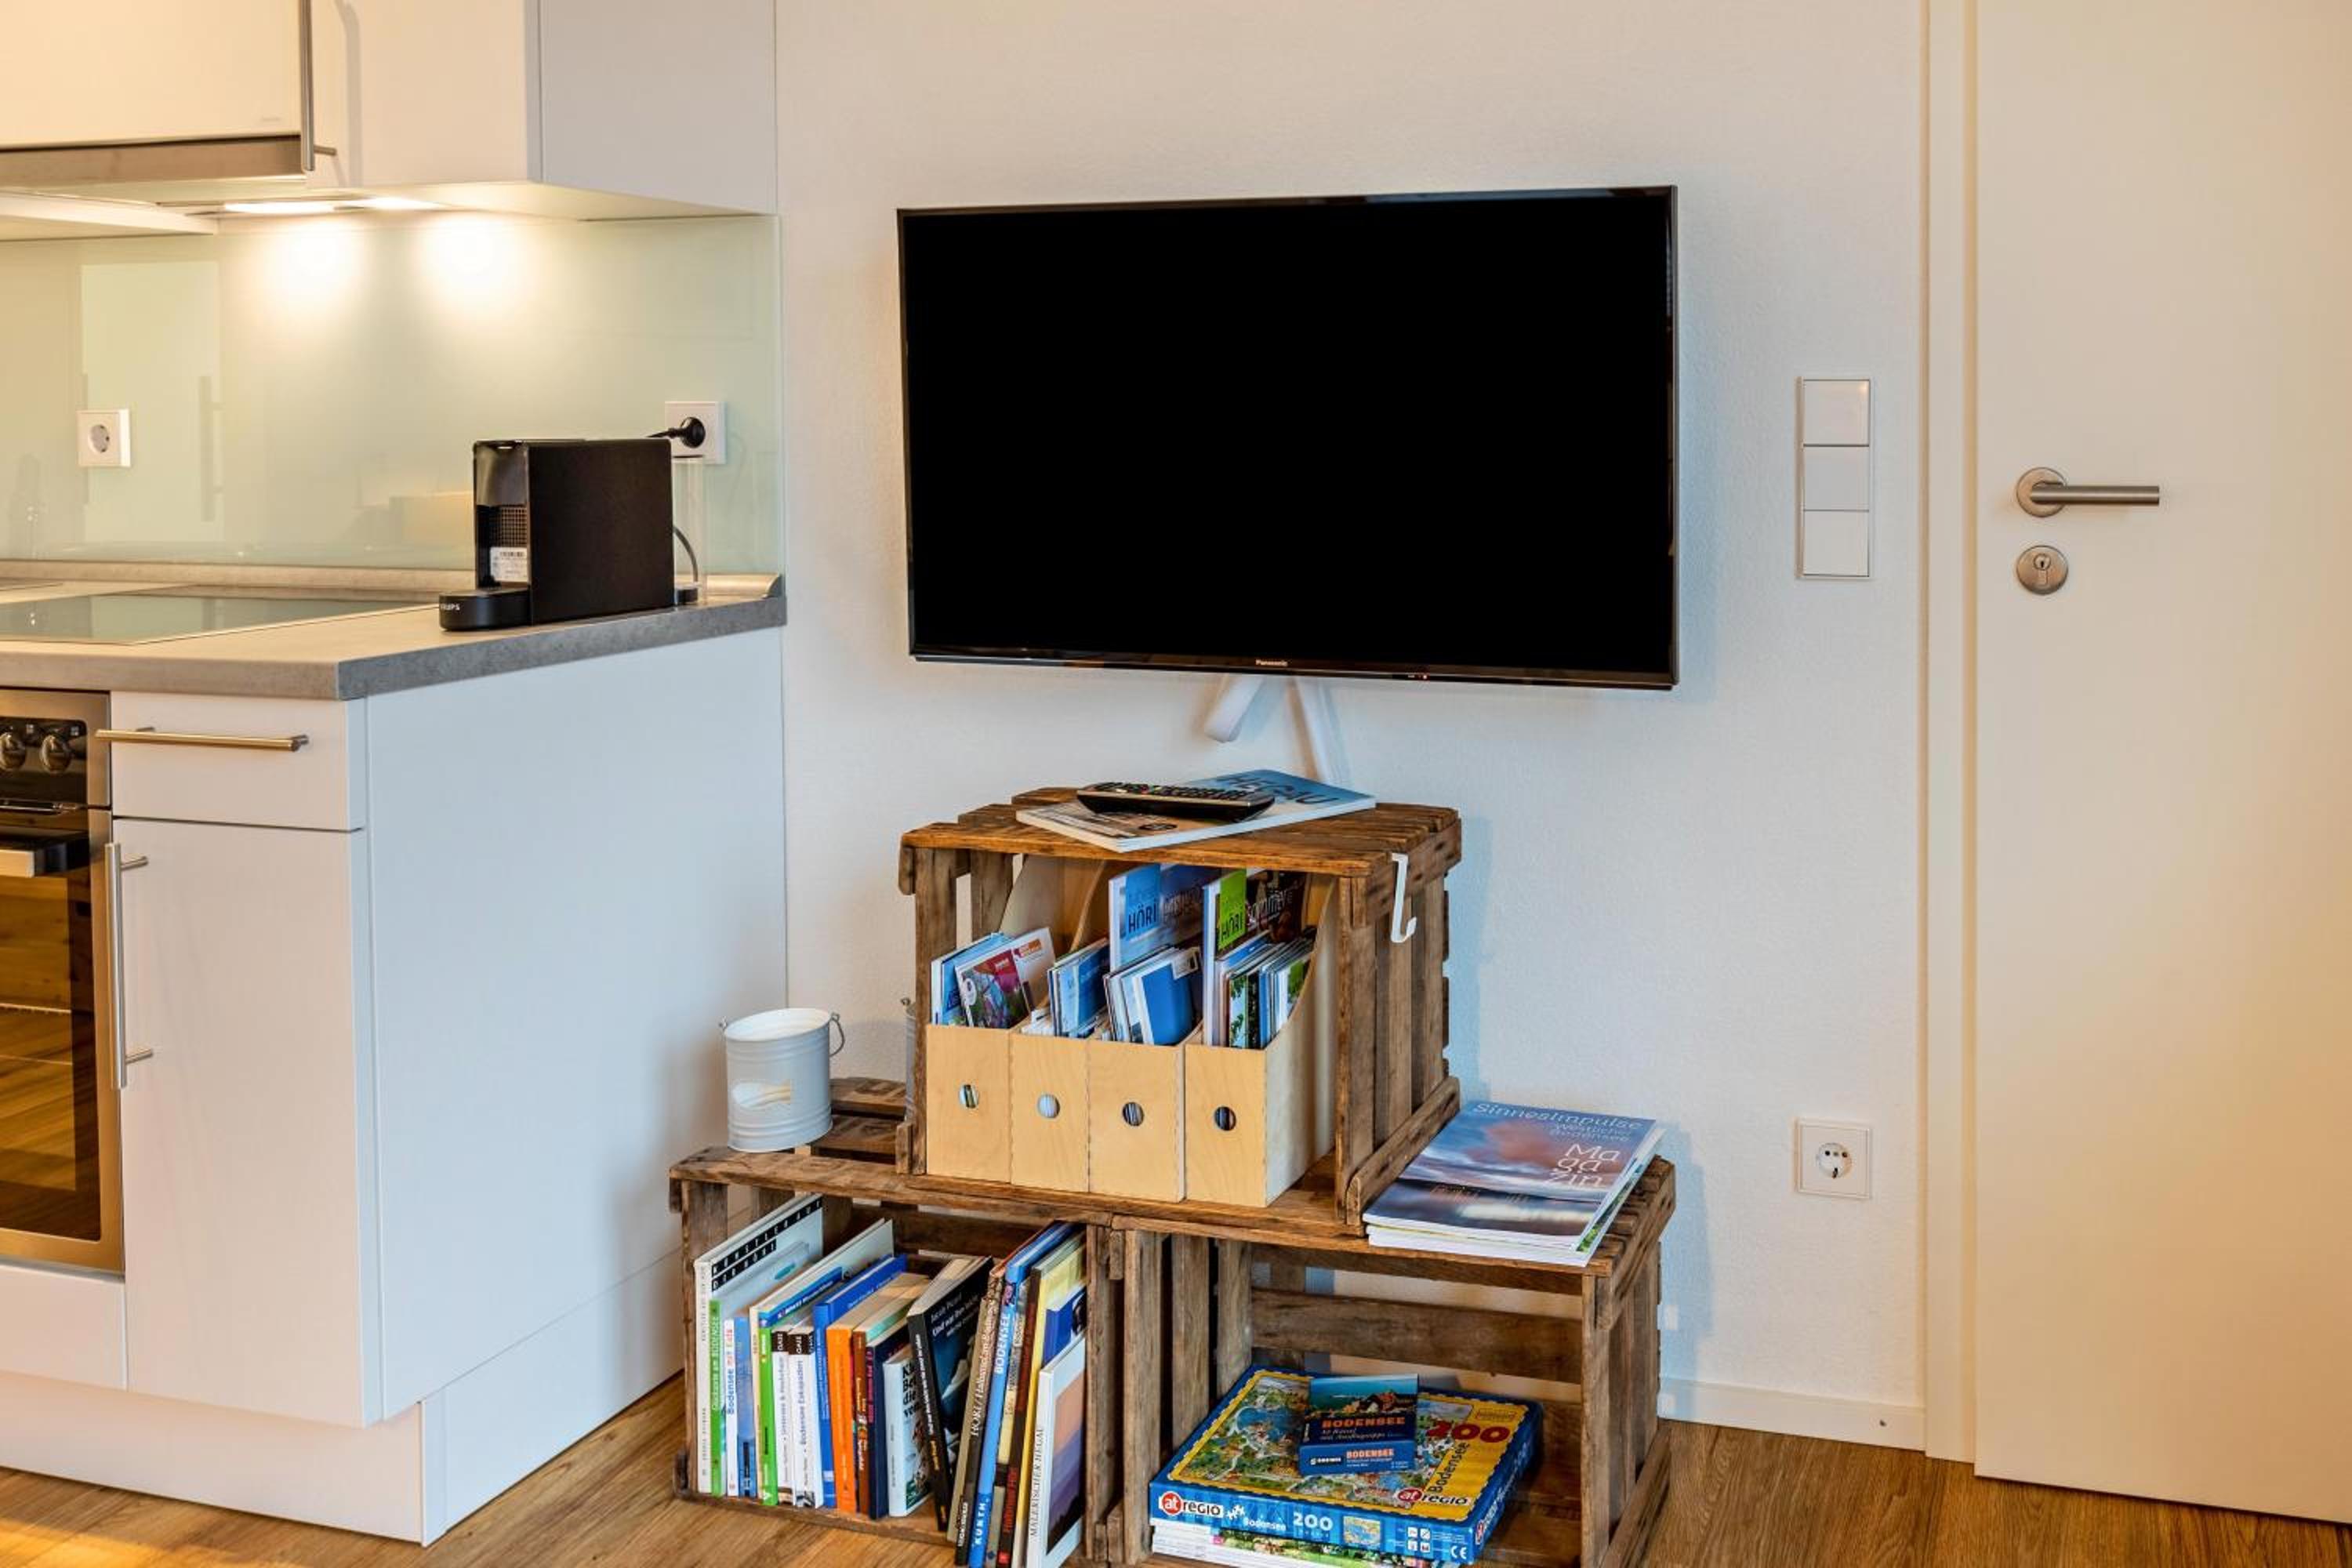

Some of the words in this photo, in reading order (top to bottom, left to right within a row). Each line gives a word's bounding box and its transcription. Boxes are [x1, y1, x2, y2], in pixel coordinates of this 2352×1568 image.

[1127, 902, 1158, 932] HÖRI
[1564, 1142, 1621, 1161] Ma
[993, 1312, 1011, 1374] BODENSEE
[1321, 1416, 1406, 1428] BODENSEE
[1425, 1421, 1511, 1443] 200
[1346, 1449, 1394, 1459] BODENSEE
[1428, 1443, 1470, 1493] Bodensee
[974, 1502, 986, 1545] KUNTH
[1243, 1517, 1287, 1531] Bodensee
[1292, 1512, 1334, 1531] 200
